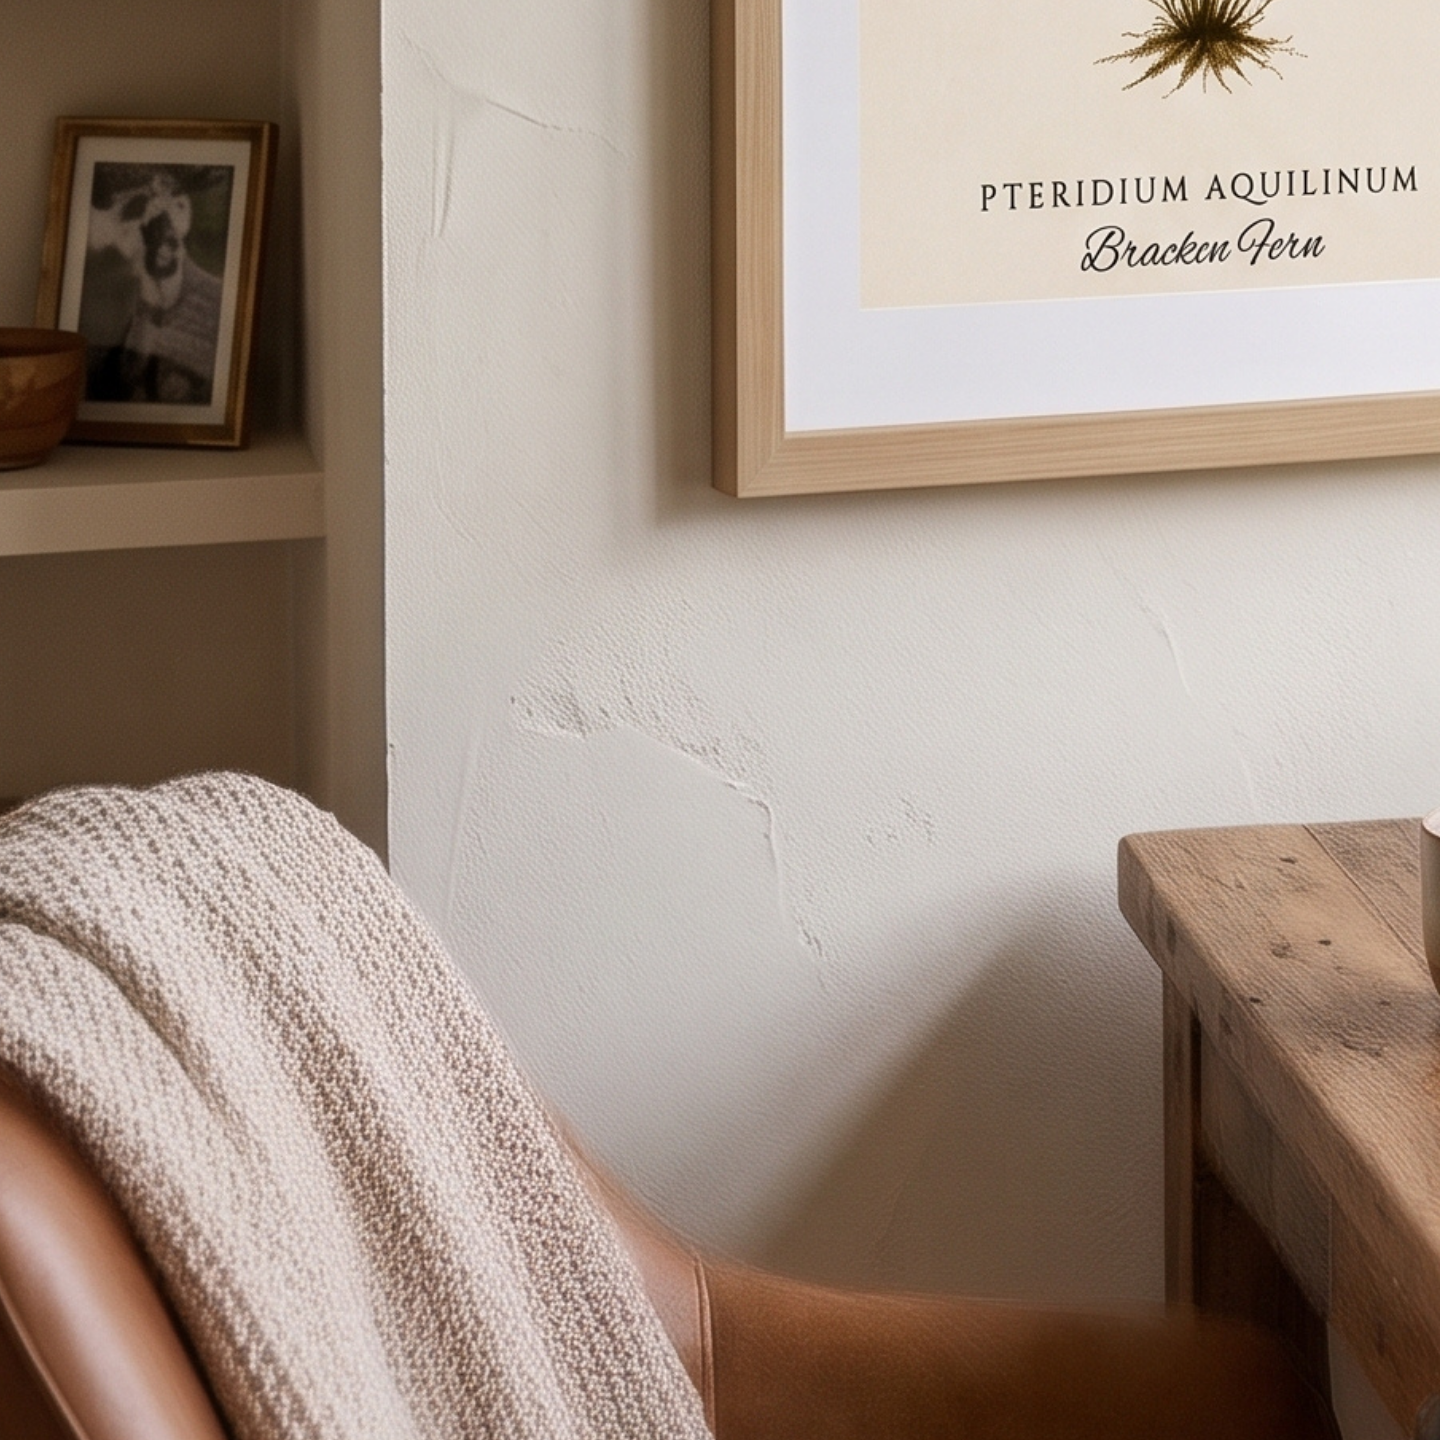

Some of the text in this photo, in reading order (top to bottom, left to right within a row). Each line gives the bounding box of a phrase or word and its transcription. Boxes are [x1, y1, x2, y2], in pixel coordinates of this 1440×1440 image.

[980, 166, 1418, 212] PTERIDIUM AQUILINUM
[1080, 217, 1326, 273] Bracken Fern
